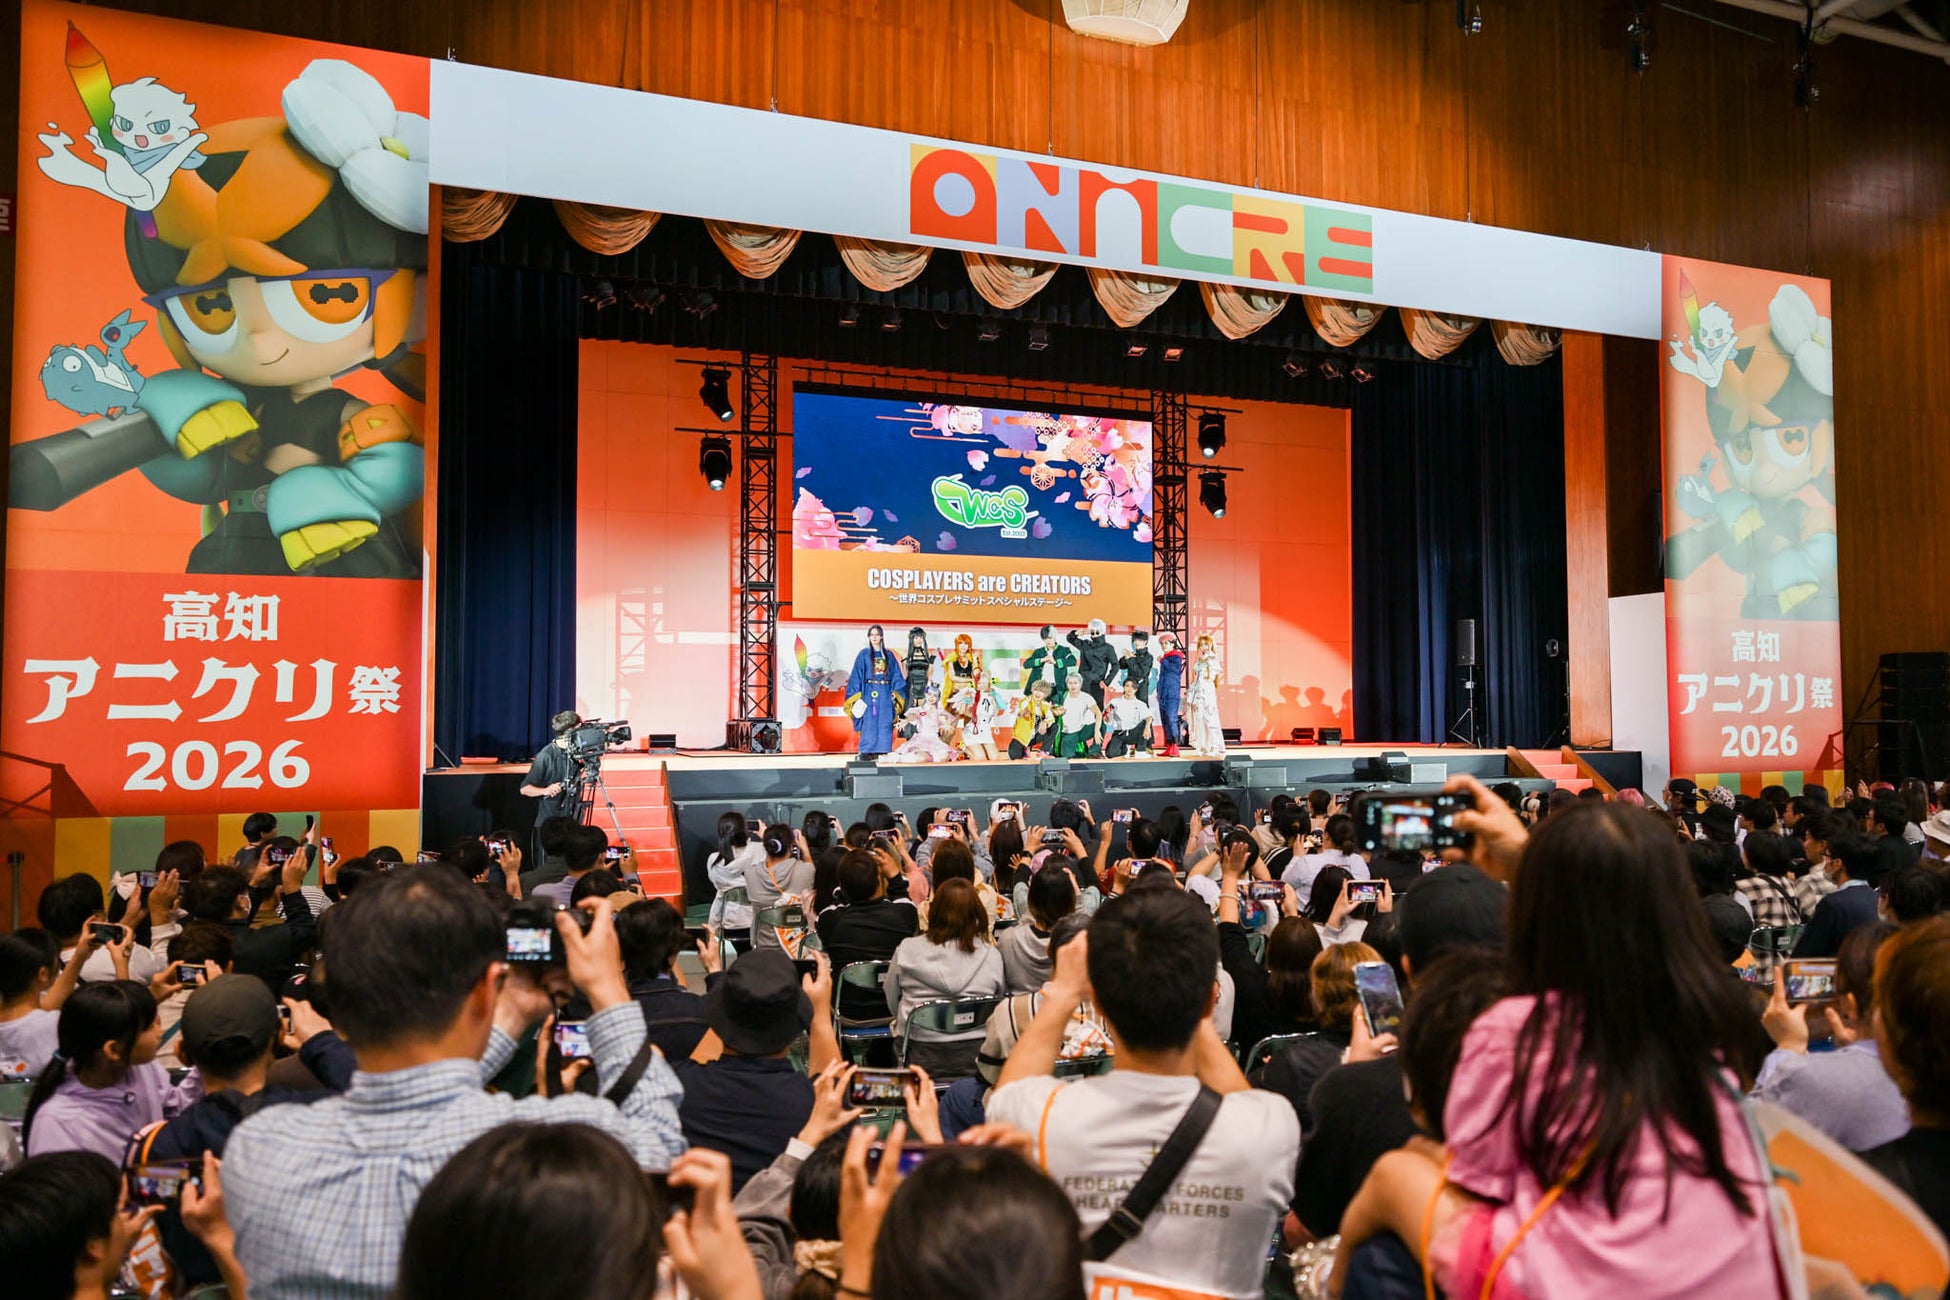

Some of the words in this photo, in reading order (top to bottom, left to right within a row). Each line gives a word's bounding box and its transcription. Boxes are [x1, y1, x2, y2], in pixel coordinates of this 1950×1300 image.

[867, 568, 974, 591] COSPLAYERS
[977, 575, 1006, 592] are
[1010, 573, 1091, 595] CREATORS
[163, 590, 281, 641] 高知
[1731, 630, 1781, 662] 高知
[23, 656, 402, 724] アニクリ祭
[1677, 672, 1834, 715] アニクリ祭
[1721, 725, 1798, 757] 2026
[123, 740, 310, 792] 2026
[1176, 1183, 1245, 1201] FORCES
